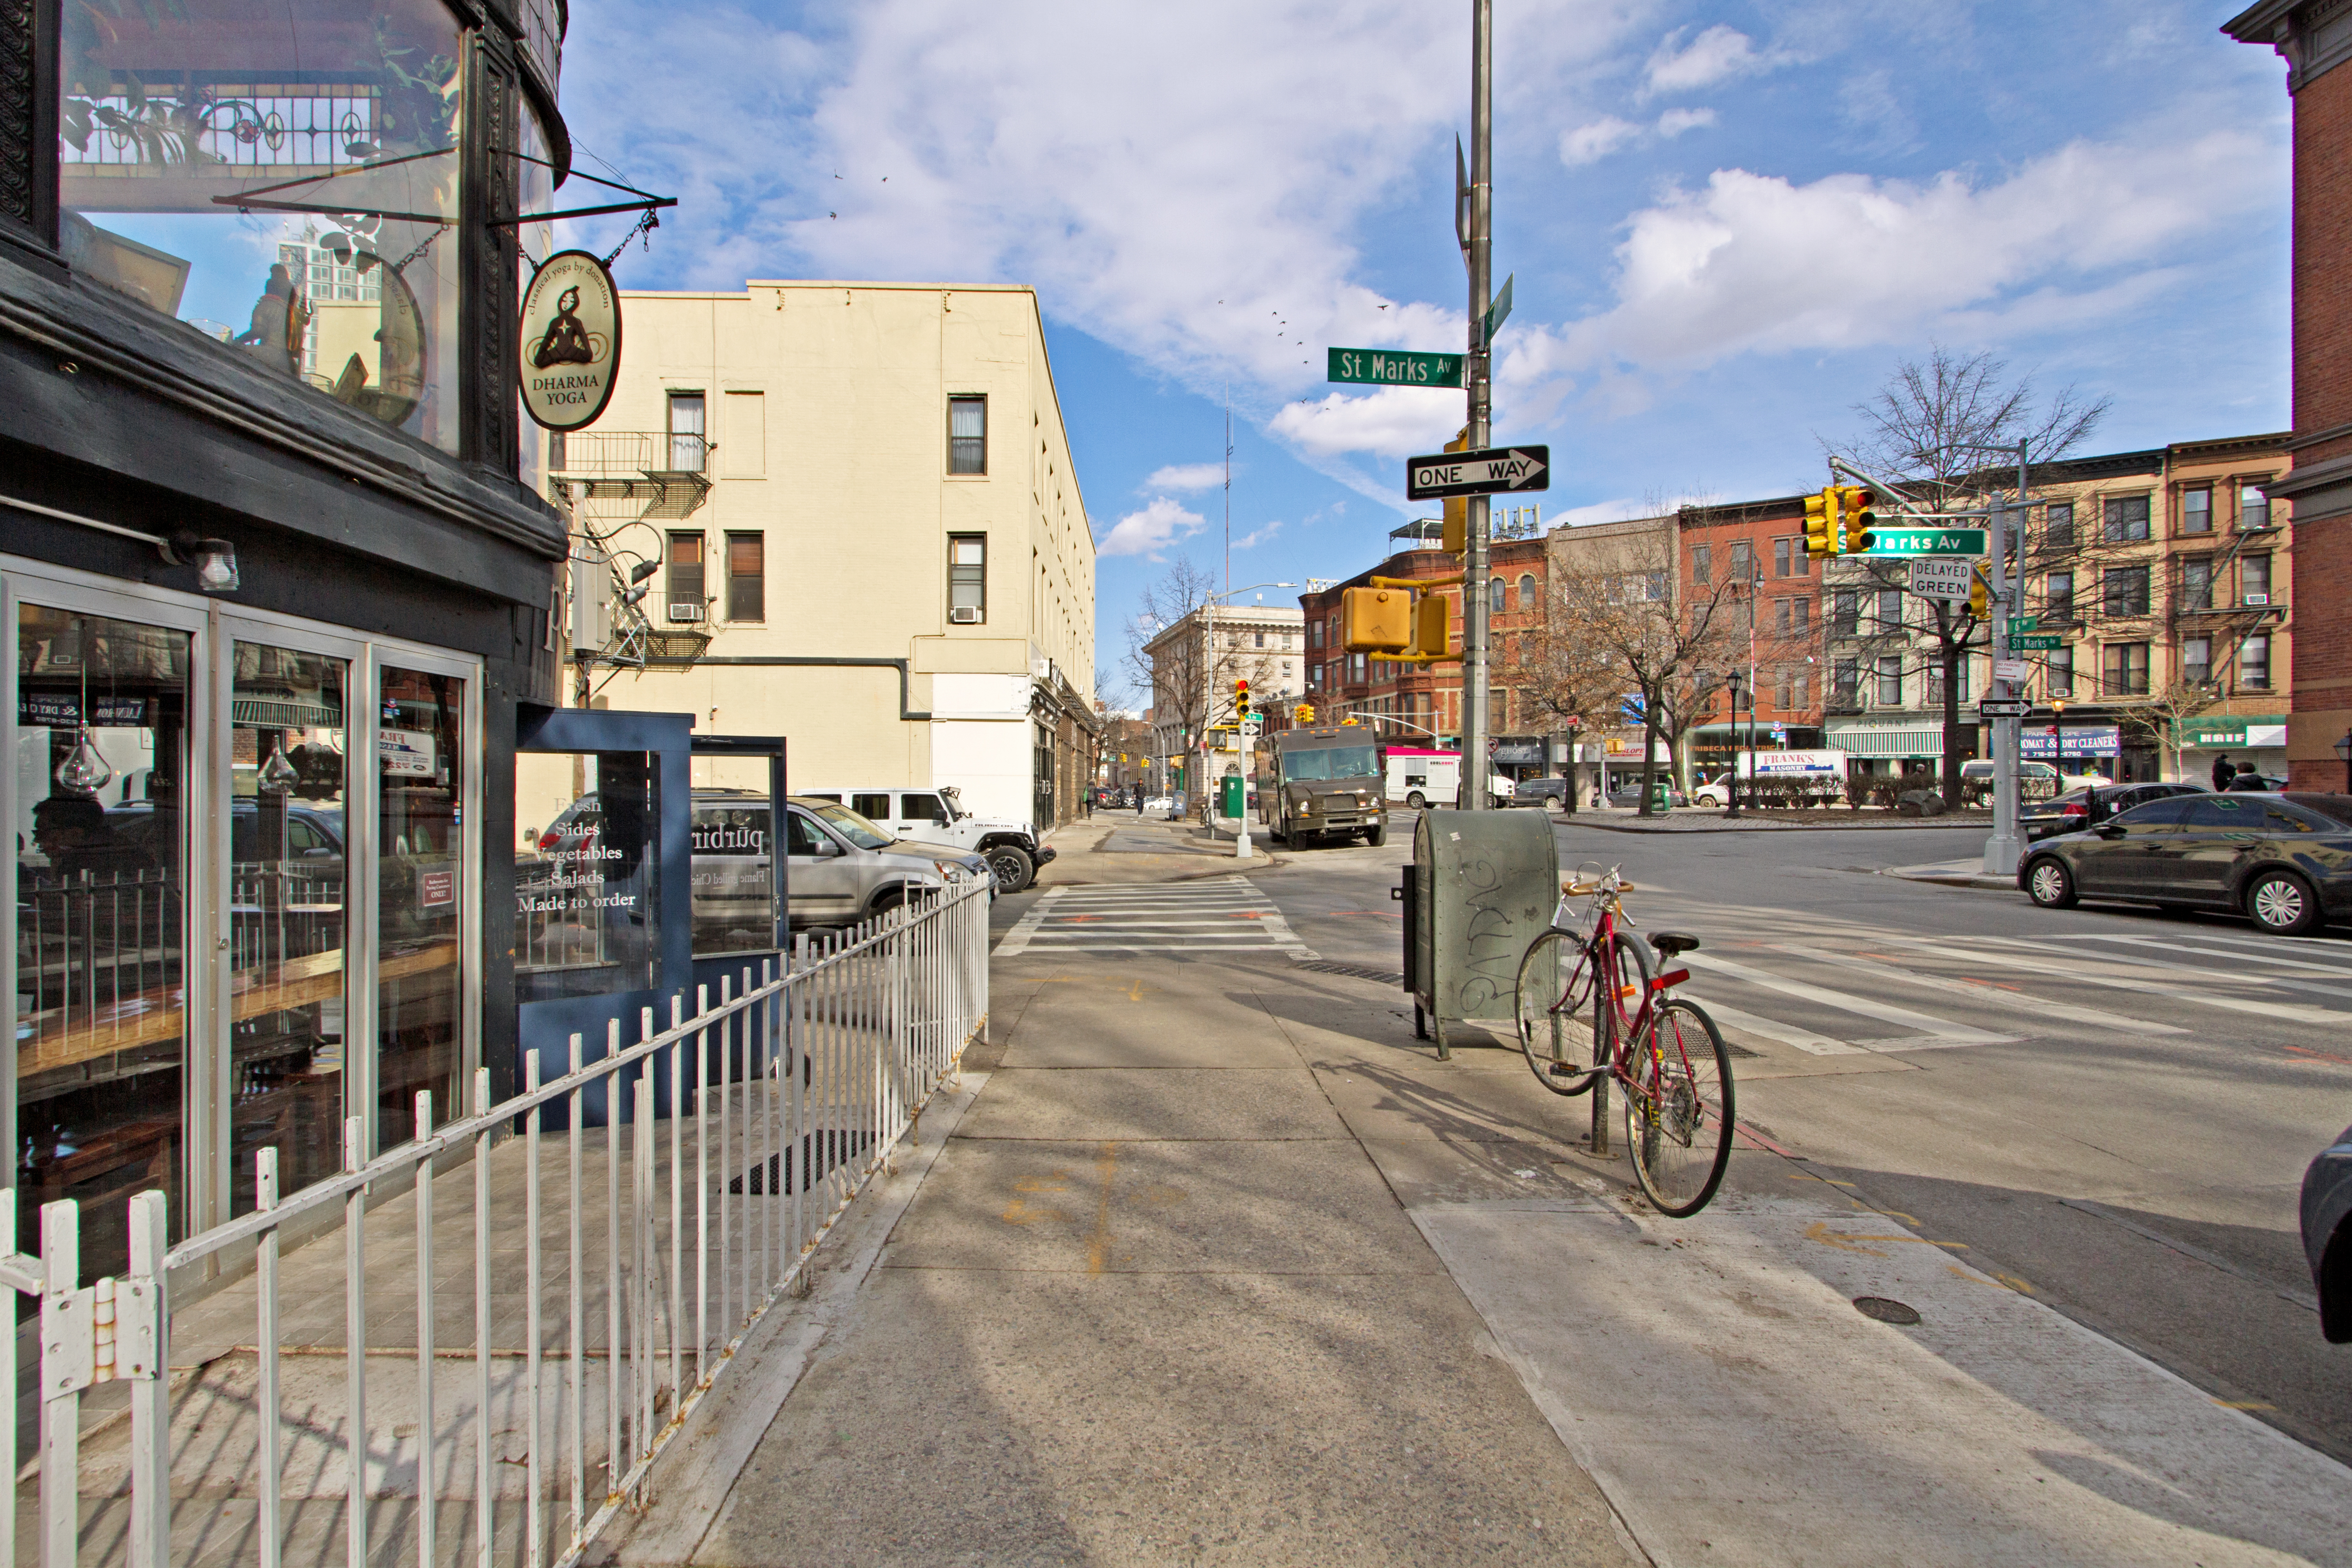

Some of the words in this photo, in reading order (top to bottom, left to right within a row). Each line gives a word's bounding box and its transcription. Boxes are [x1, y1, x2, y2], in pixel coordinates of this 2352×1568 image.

[528, 272, 551, 315] classical
[552, 265, 571, 278] yoga
[574, 261, 584, 274] by
[586, 266, 608, 309] donation
[1341, 352, 1362, 378] St
[1372, 354, 1427, 382] Marks
[1437, 358, 1451, 373] Av
[533, 375, 599, 391] DHARMA
[546, 391, 587, 405] YOGA
[1419, 466, 1462, 486] ONE
[1487, 460, 1532, 479] WAY
[1937, 535, 1961, 549] Av
[1916, 563, 1967, 577] DELAYED
[1916, 580, 1966, 594] GREEN
[2014, 620, 2020, 631] 6
[2012, 638, 2021, 648] St
[2024, 638, 2047, 648] Marks
[1856, 720, 1910, 728] PIQUANT
[2047, 738, 2058, 748] &
[2061, 739, 2078, 748] DRY
[2078, 735, 2117, 748] CLEANERS
[1764, 754, 1814, 765] FRANK'S
[554, 798, 602, 812] Fresh
[556, 822, 600, 836] Sides
[533, 845, 623, 865] Vegetables
[551, 870, 605, 885] Salads
[517, 896, 566, 912] Made
[571, 897, 588, 909] to
[593, 892, 636, 907] order
